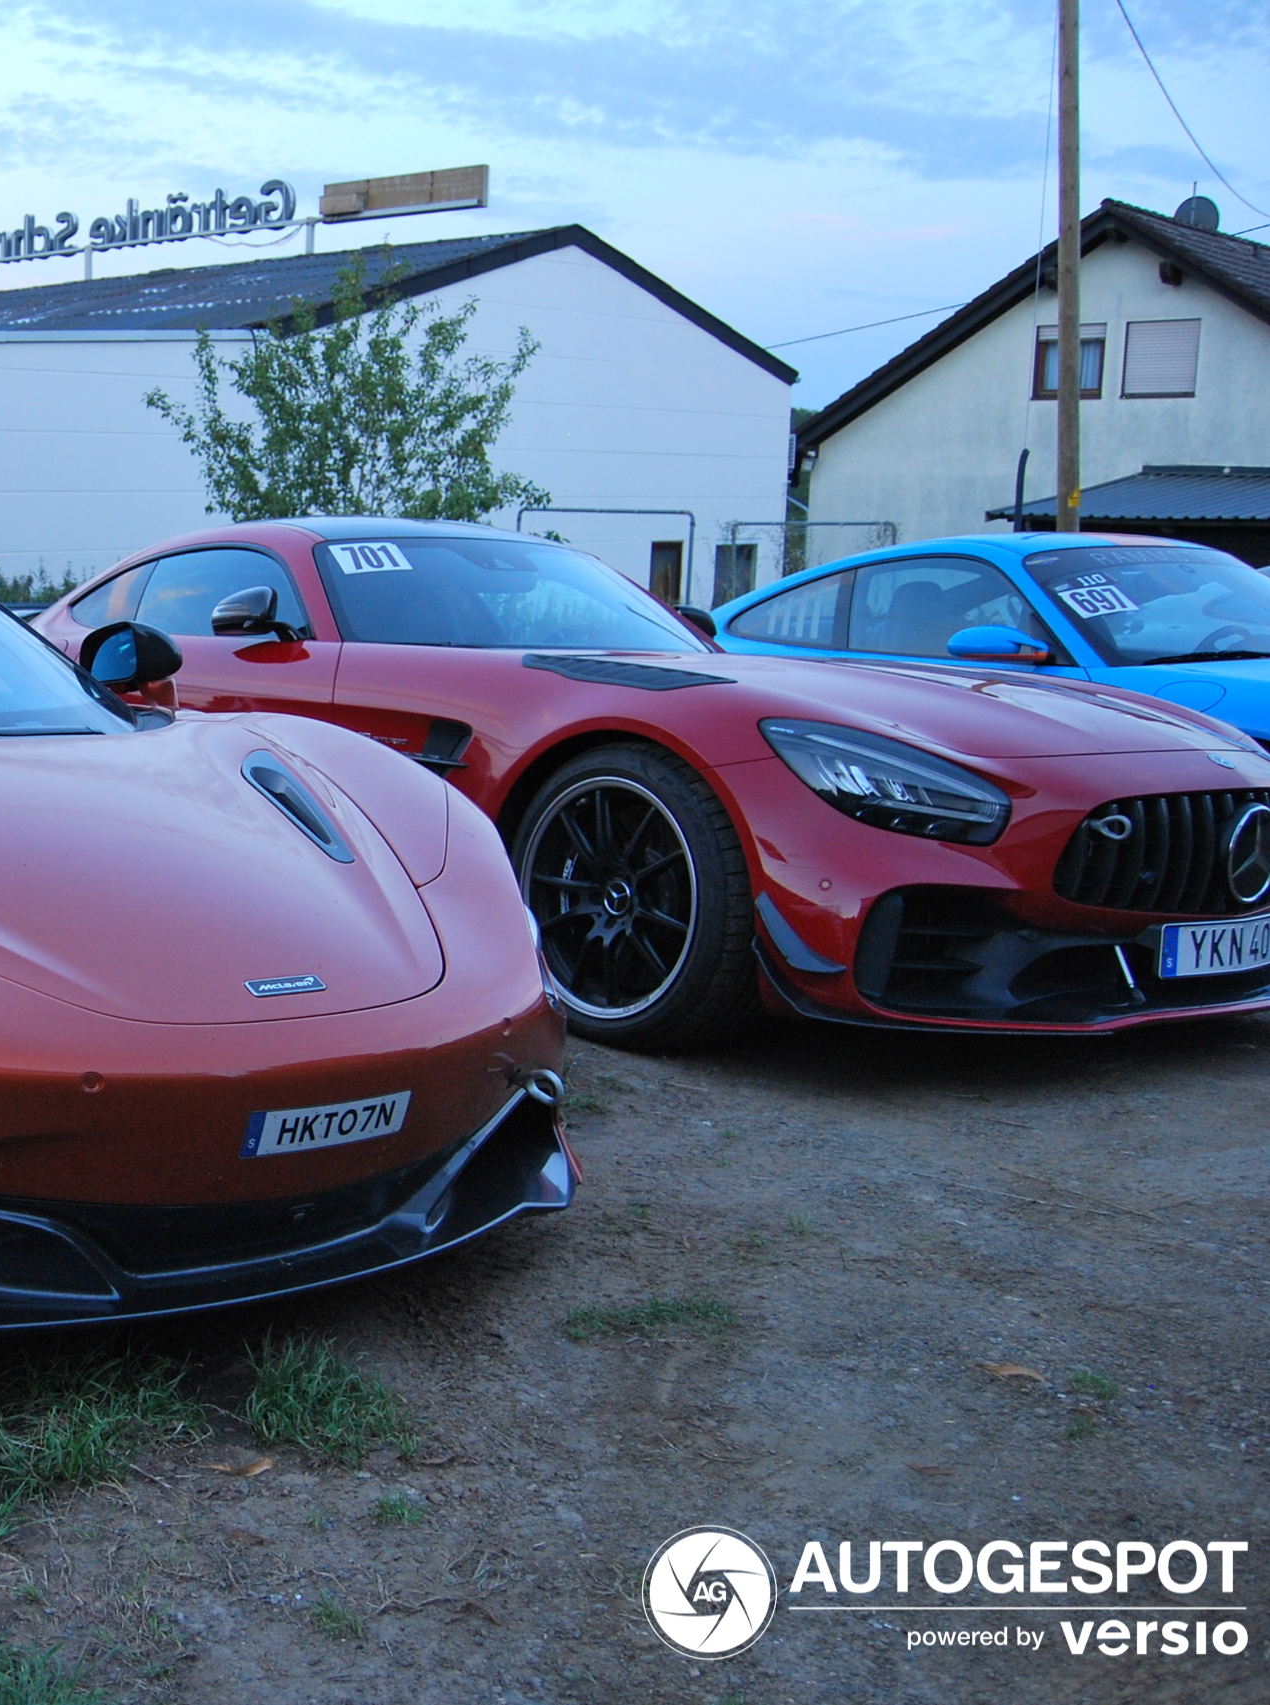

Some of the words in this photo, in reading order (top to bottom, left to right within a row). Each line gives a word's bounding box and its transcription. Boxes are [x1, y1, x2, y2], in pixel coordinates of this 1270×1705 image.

[340, 545, 401, 570] 701
[1069, 588, 1128, 613] 697
[1166, 957, 1173, 968] S
[1190, 926, 1244, 968] YKN
[248, 1138, 255, 1149] S
